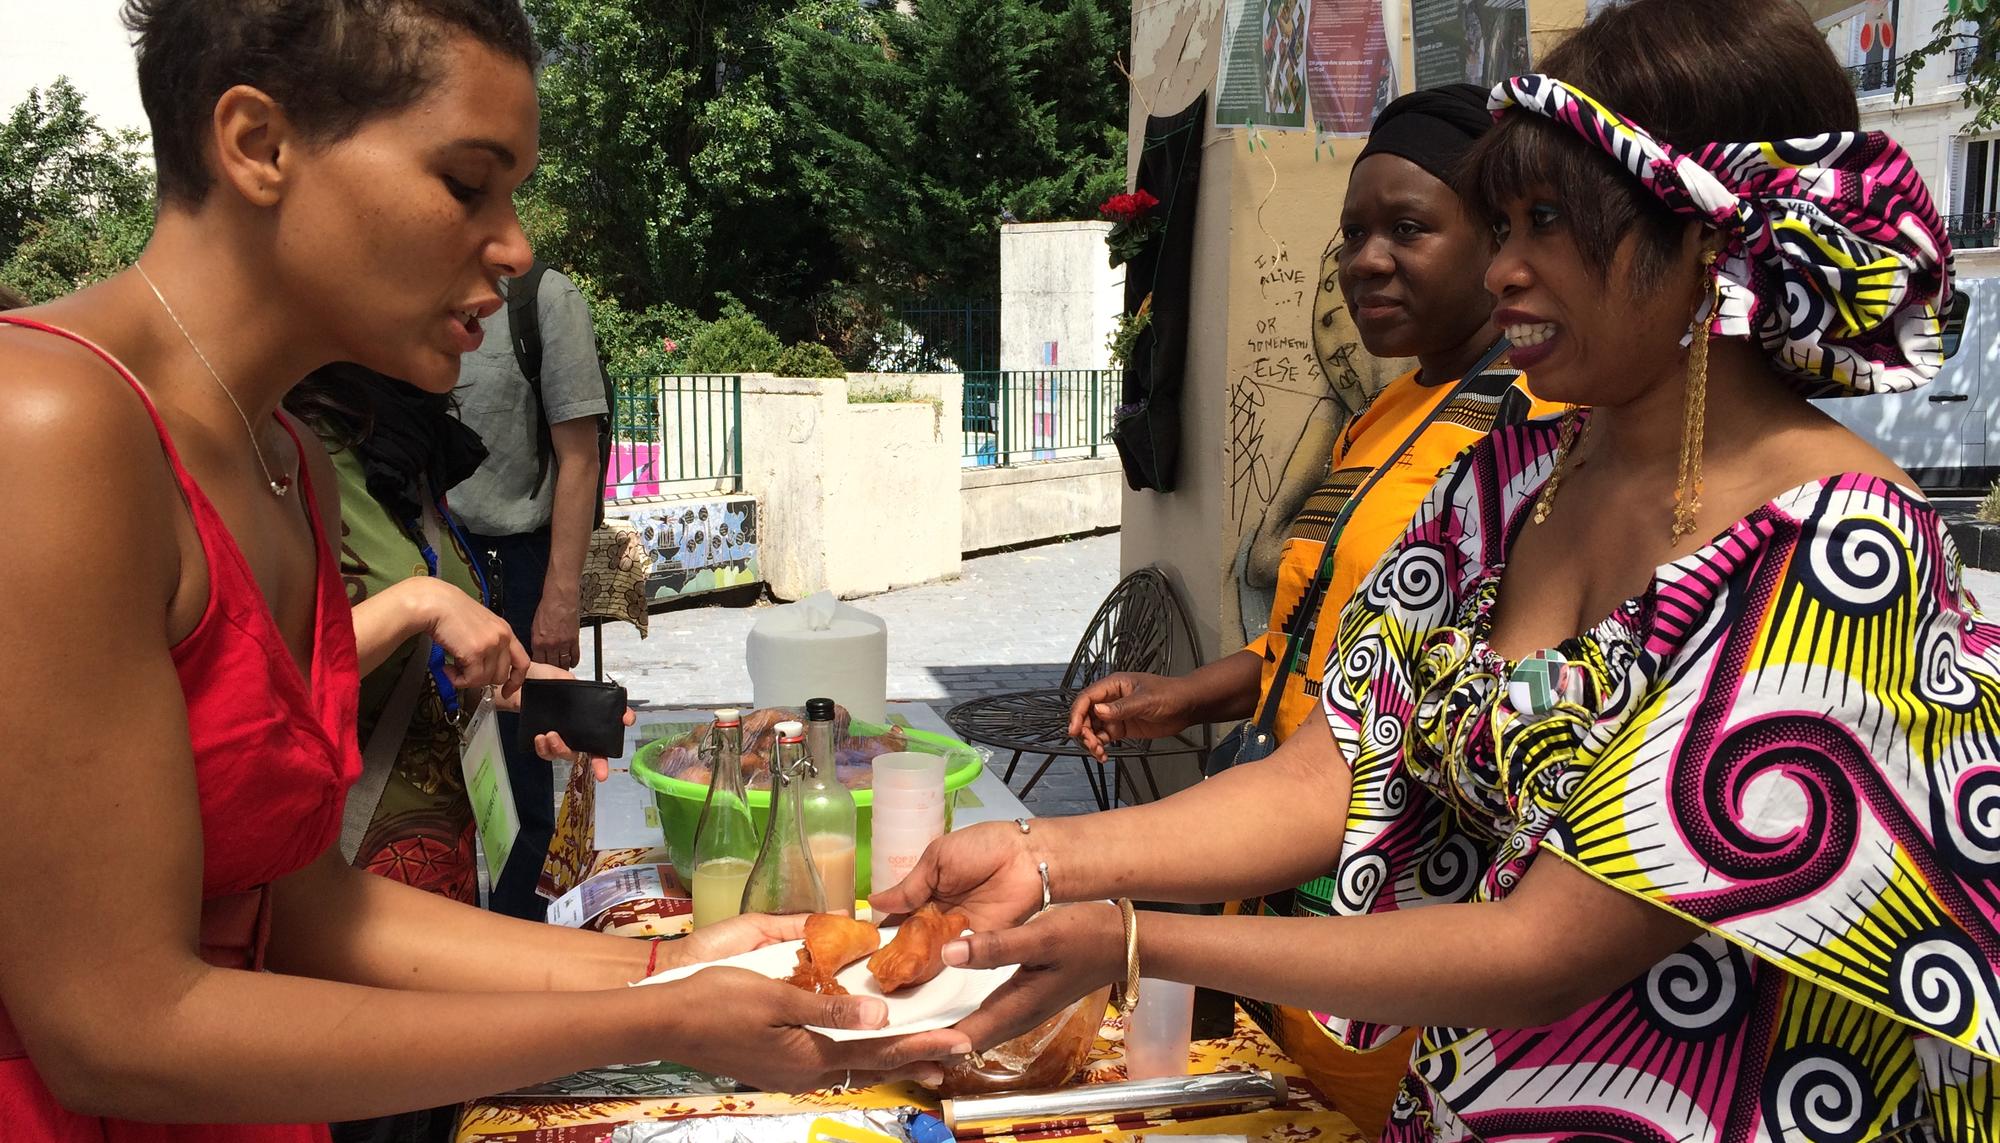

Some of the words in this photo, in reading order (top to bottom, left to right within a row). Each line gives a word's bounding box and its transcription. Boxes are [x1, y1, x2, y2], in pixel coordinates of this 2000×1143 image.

[1260, 269, 1305, 285] ALIVE
[1256, 317, 1276, 334] OR
[1254, 357, 1299, 382] ELSE
